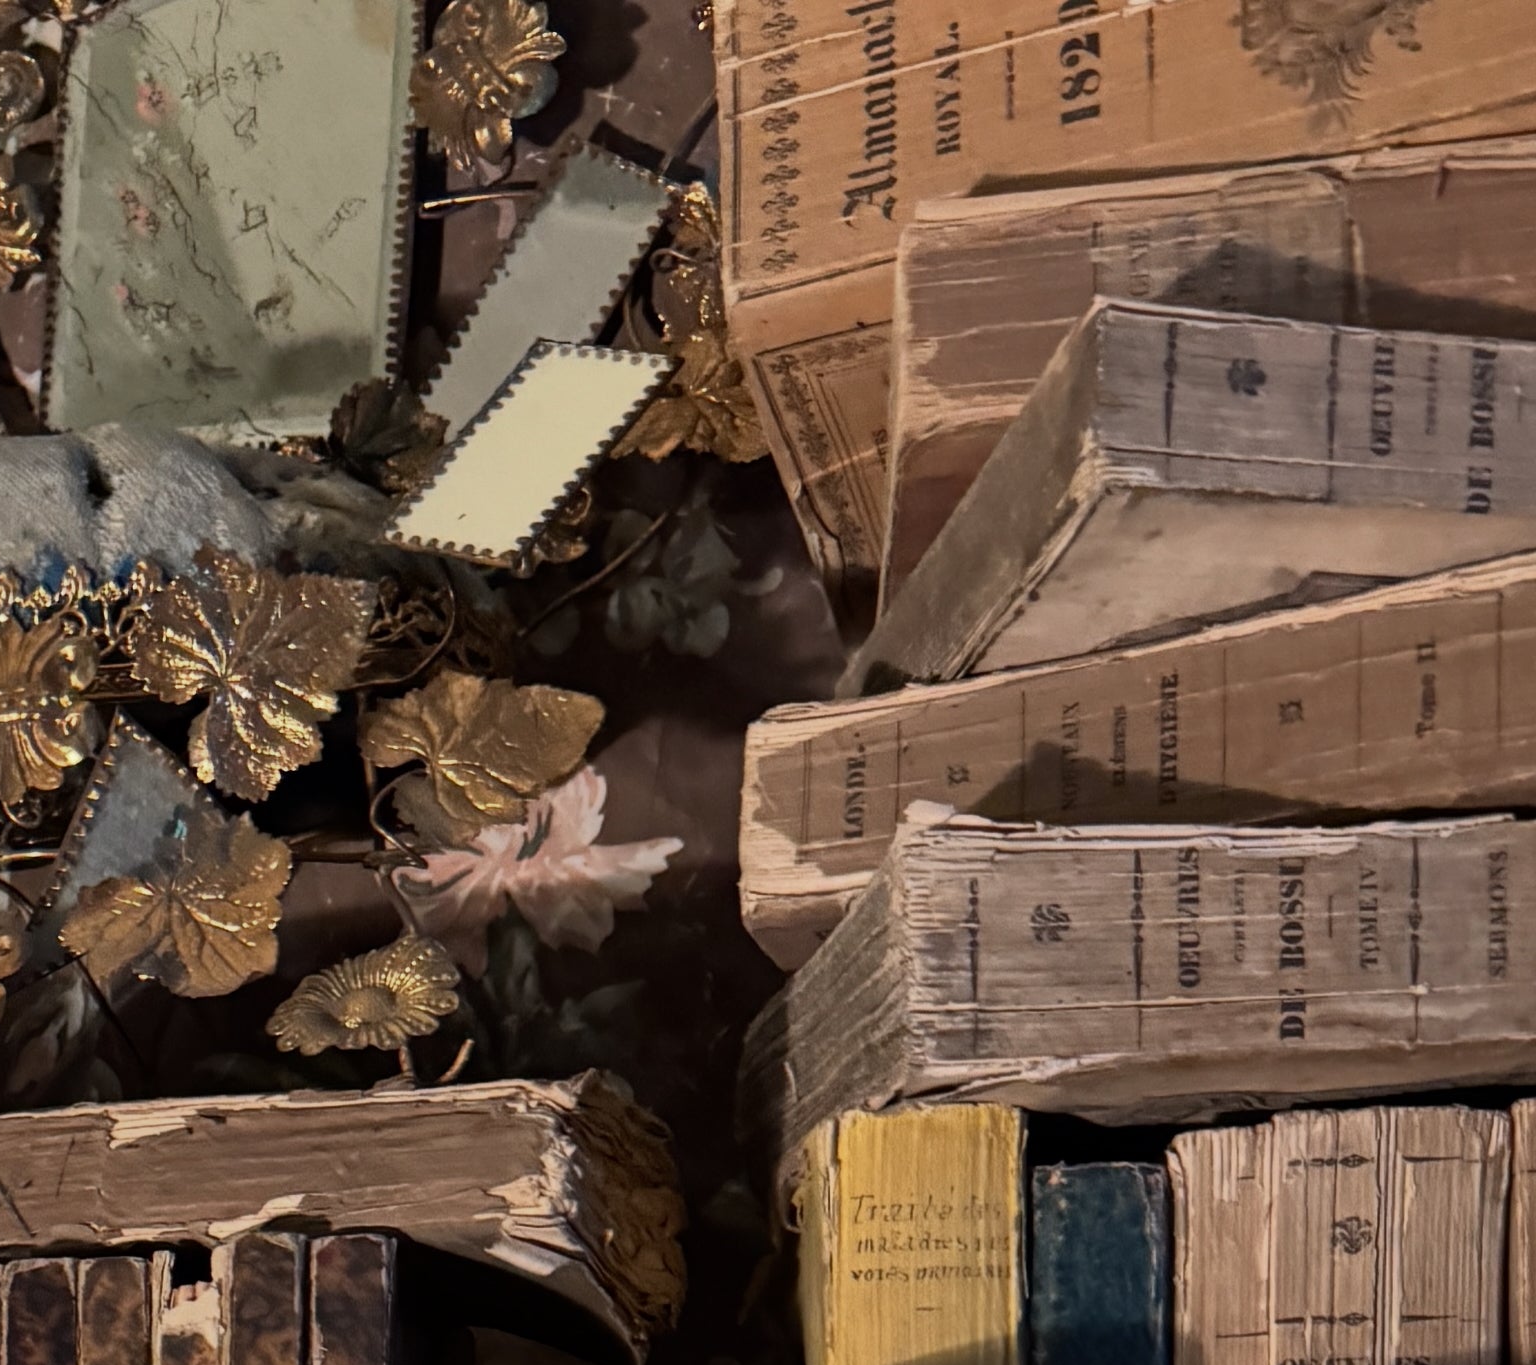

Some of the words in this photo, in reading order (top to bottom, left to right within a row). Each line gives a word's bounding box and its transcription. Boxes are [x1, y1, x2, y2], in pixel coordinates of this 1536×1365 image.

[1359, 900, 1379, 970] TOME
[1486, 848, 1510, 979] SERMONS
[1279, 988, 1306, 1041] DE
